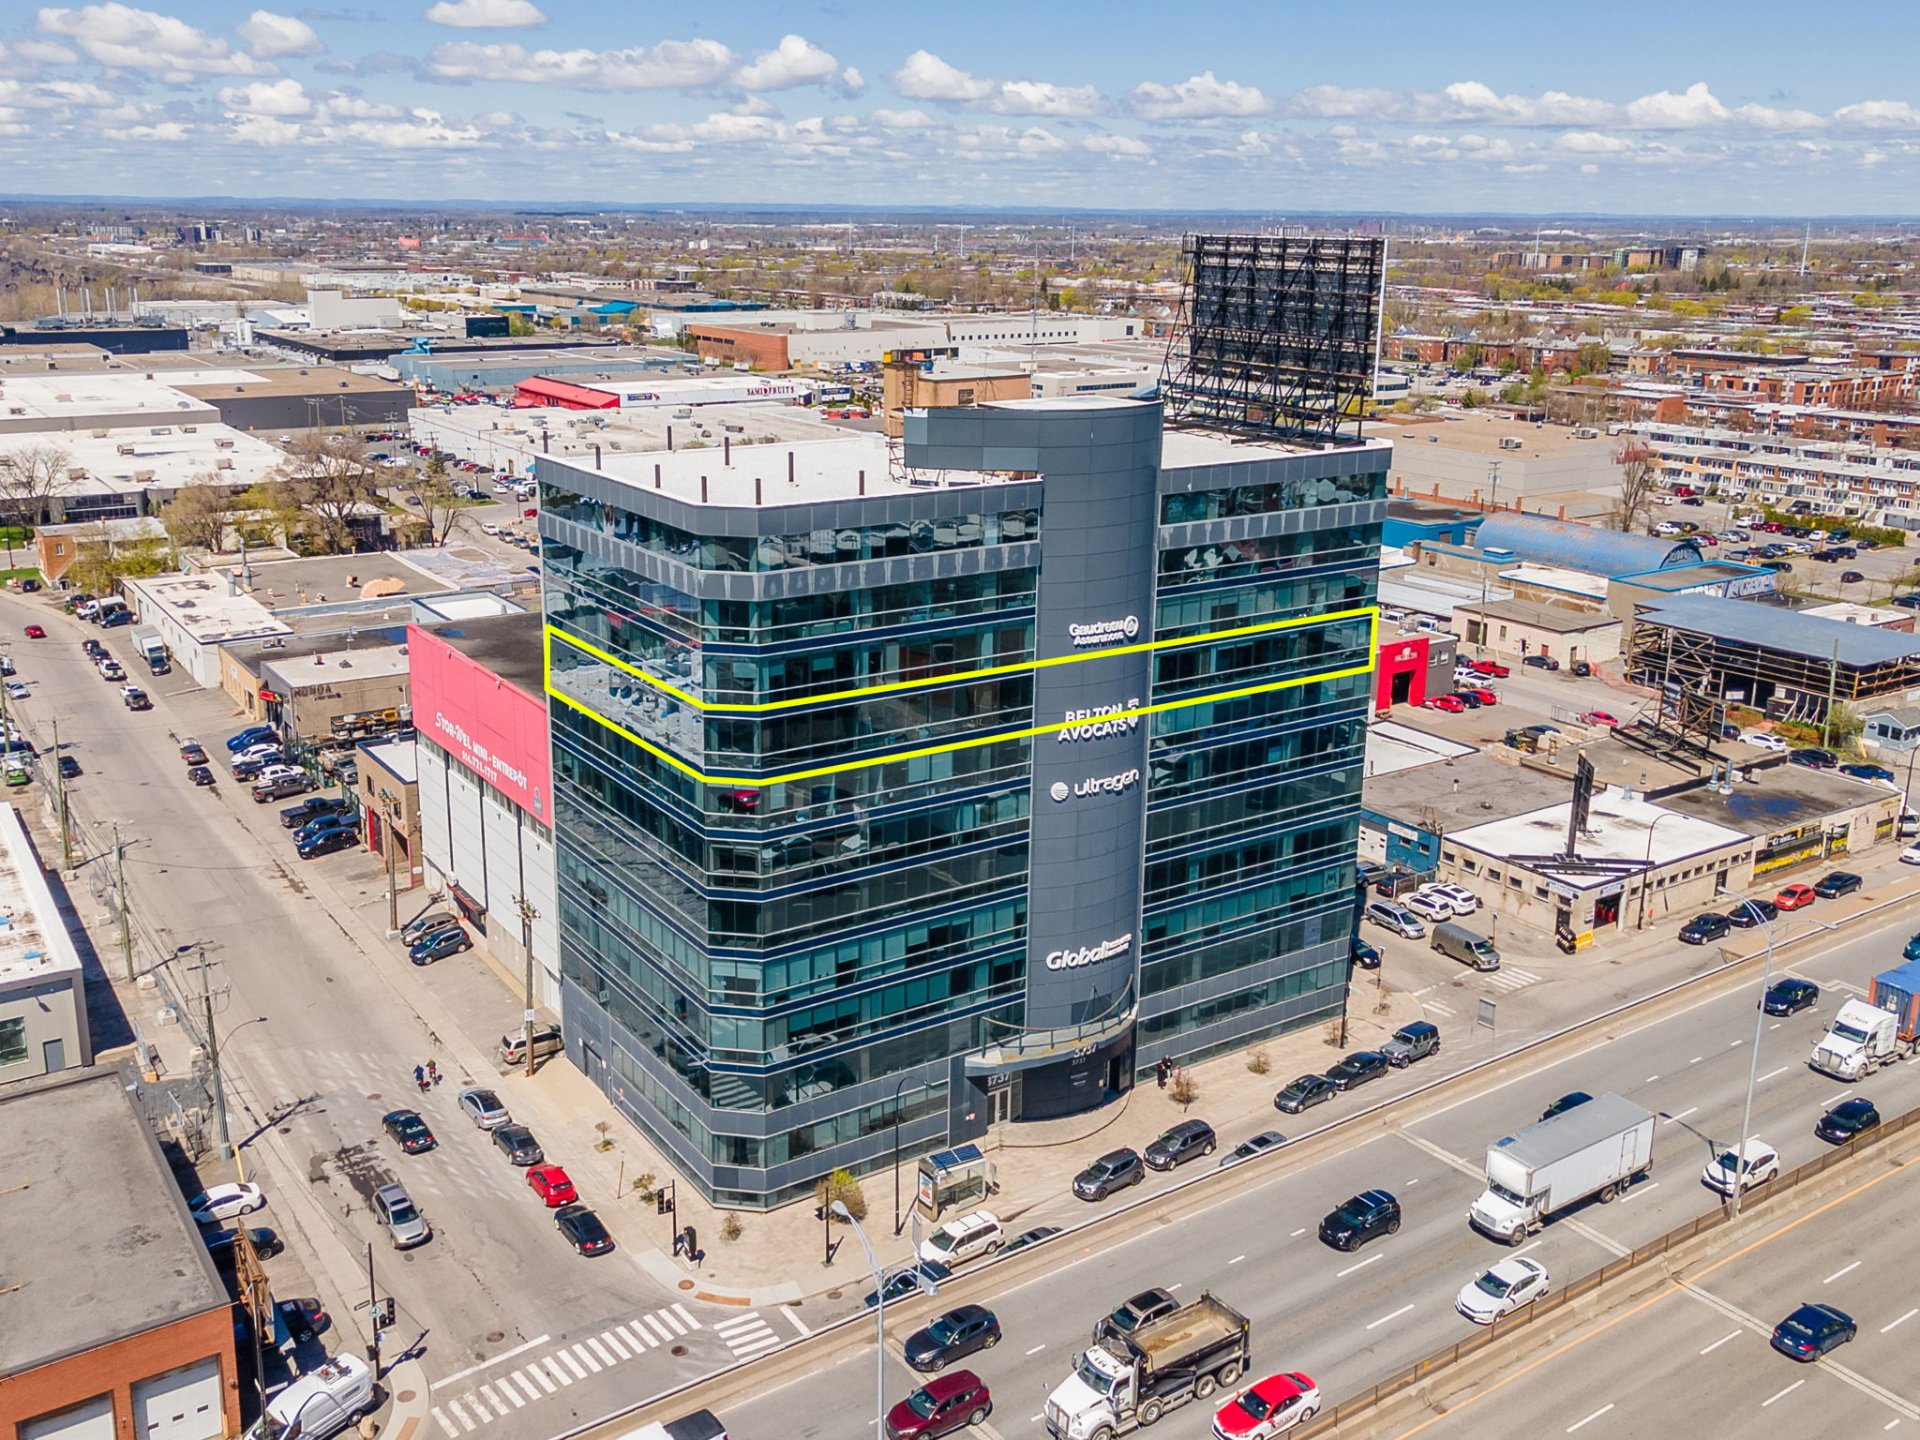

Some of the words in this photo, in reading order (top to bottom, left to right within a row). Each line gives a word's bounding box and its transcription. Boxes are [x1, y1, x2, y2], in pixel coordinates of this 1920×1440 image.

[1068, 619, 1125, 637] Gaudreau
[1073, 631, 1125, 646] Assurances
[1058, 718, 1128, 742] AVOCATS
[1074, 768, 1140, 796] ultragen
[1046, 941, 1108, 970] Global
[988, 1071, 1010, 1087] 3737
